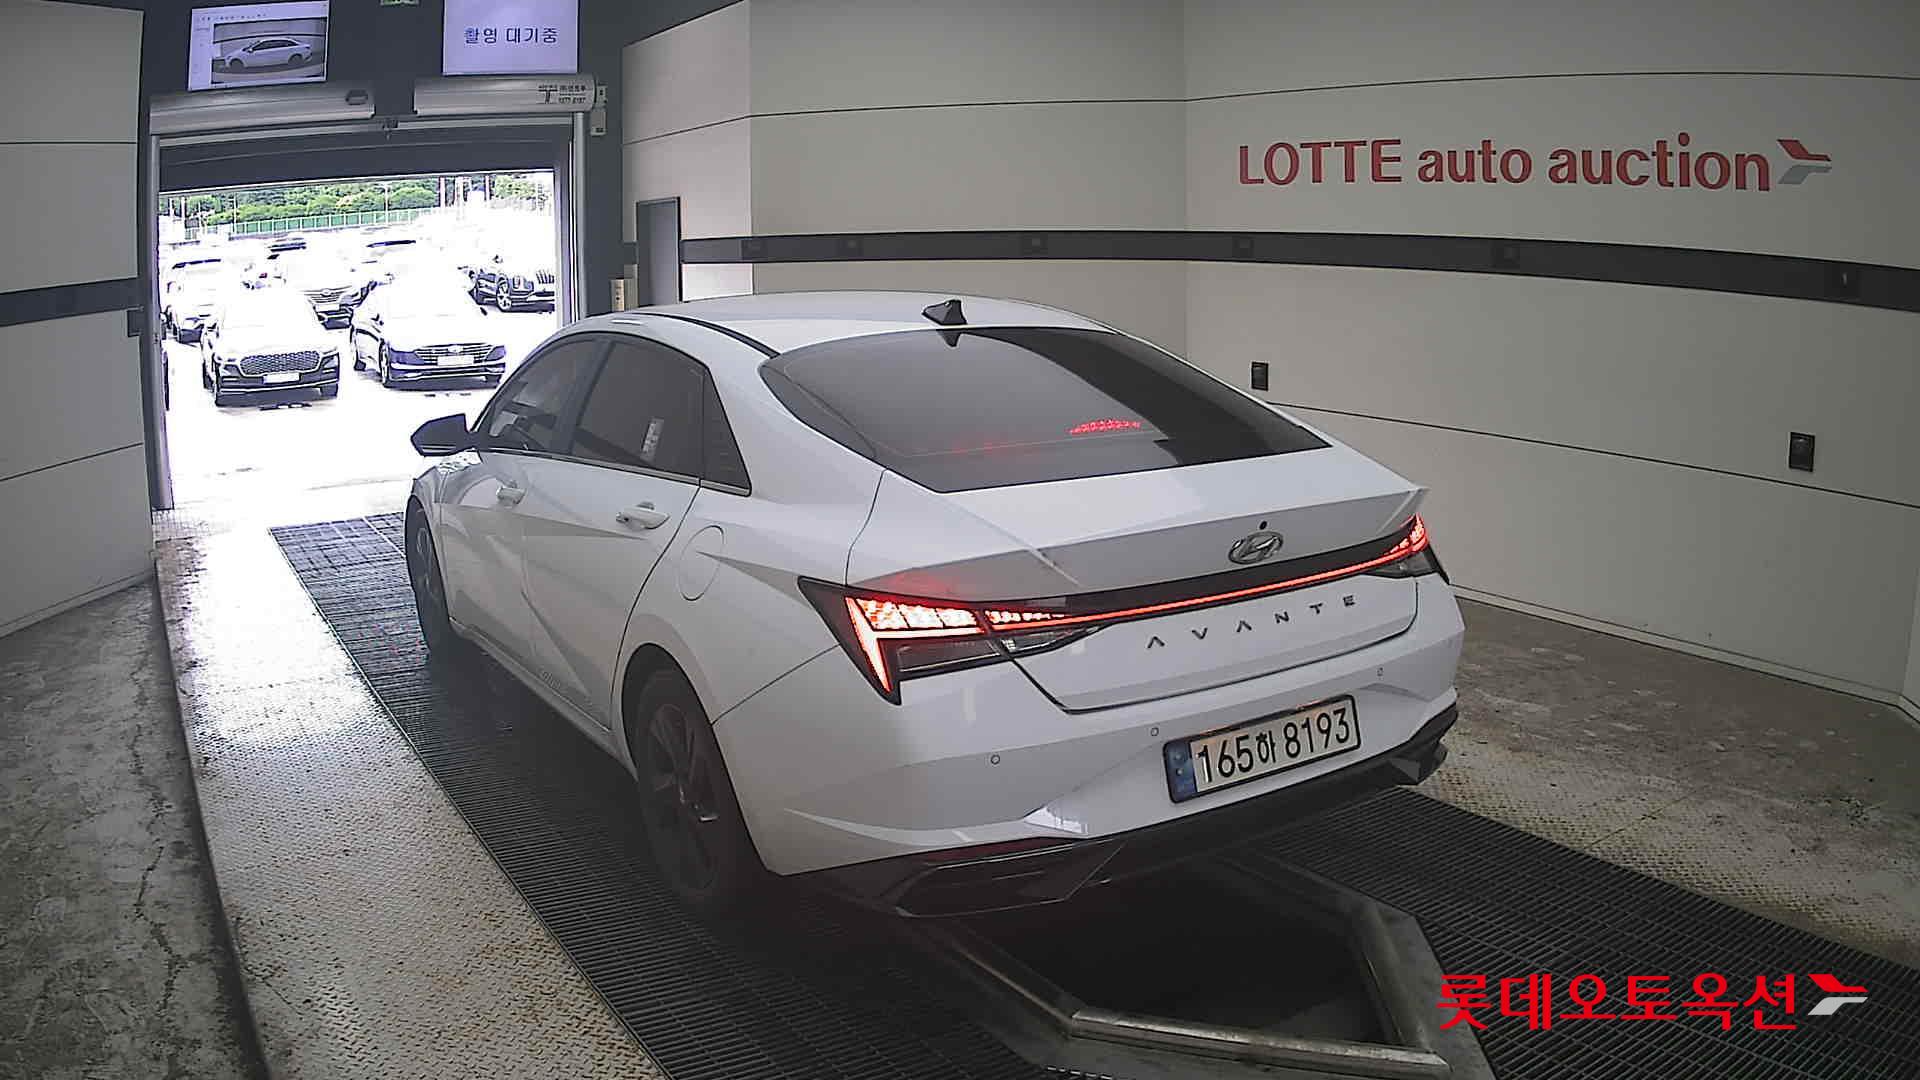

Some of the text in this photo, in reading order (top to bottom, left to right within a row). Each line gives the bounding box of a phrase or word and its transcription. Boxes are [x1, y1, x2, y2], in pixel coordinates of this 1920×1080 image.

[506, 27, 558, 43] 대기중
[1239, 132, 1770, 191] LOTTE auto auction
[1147, 595, 1355, 649] AVANTE
[1198, 708, 1350, 783] 165하 8193
